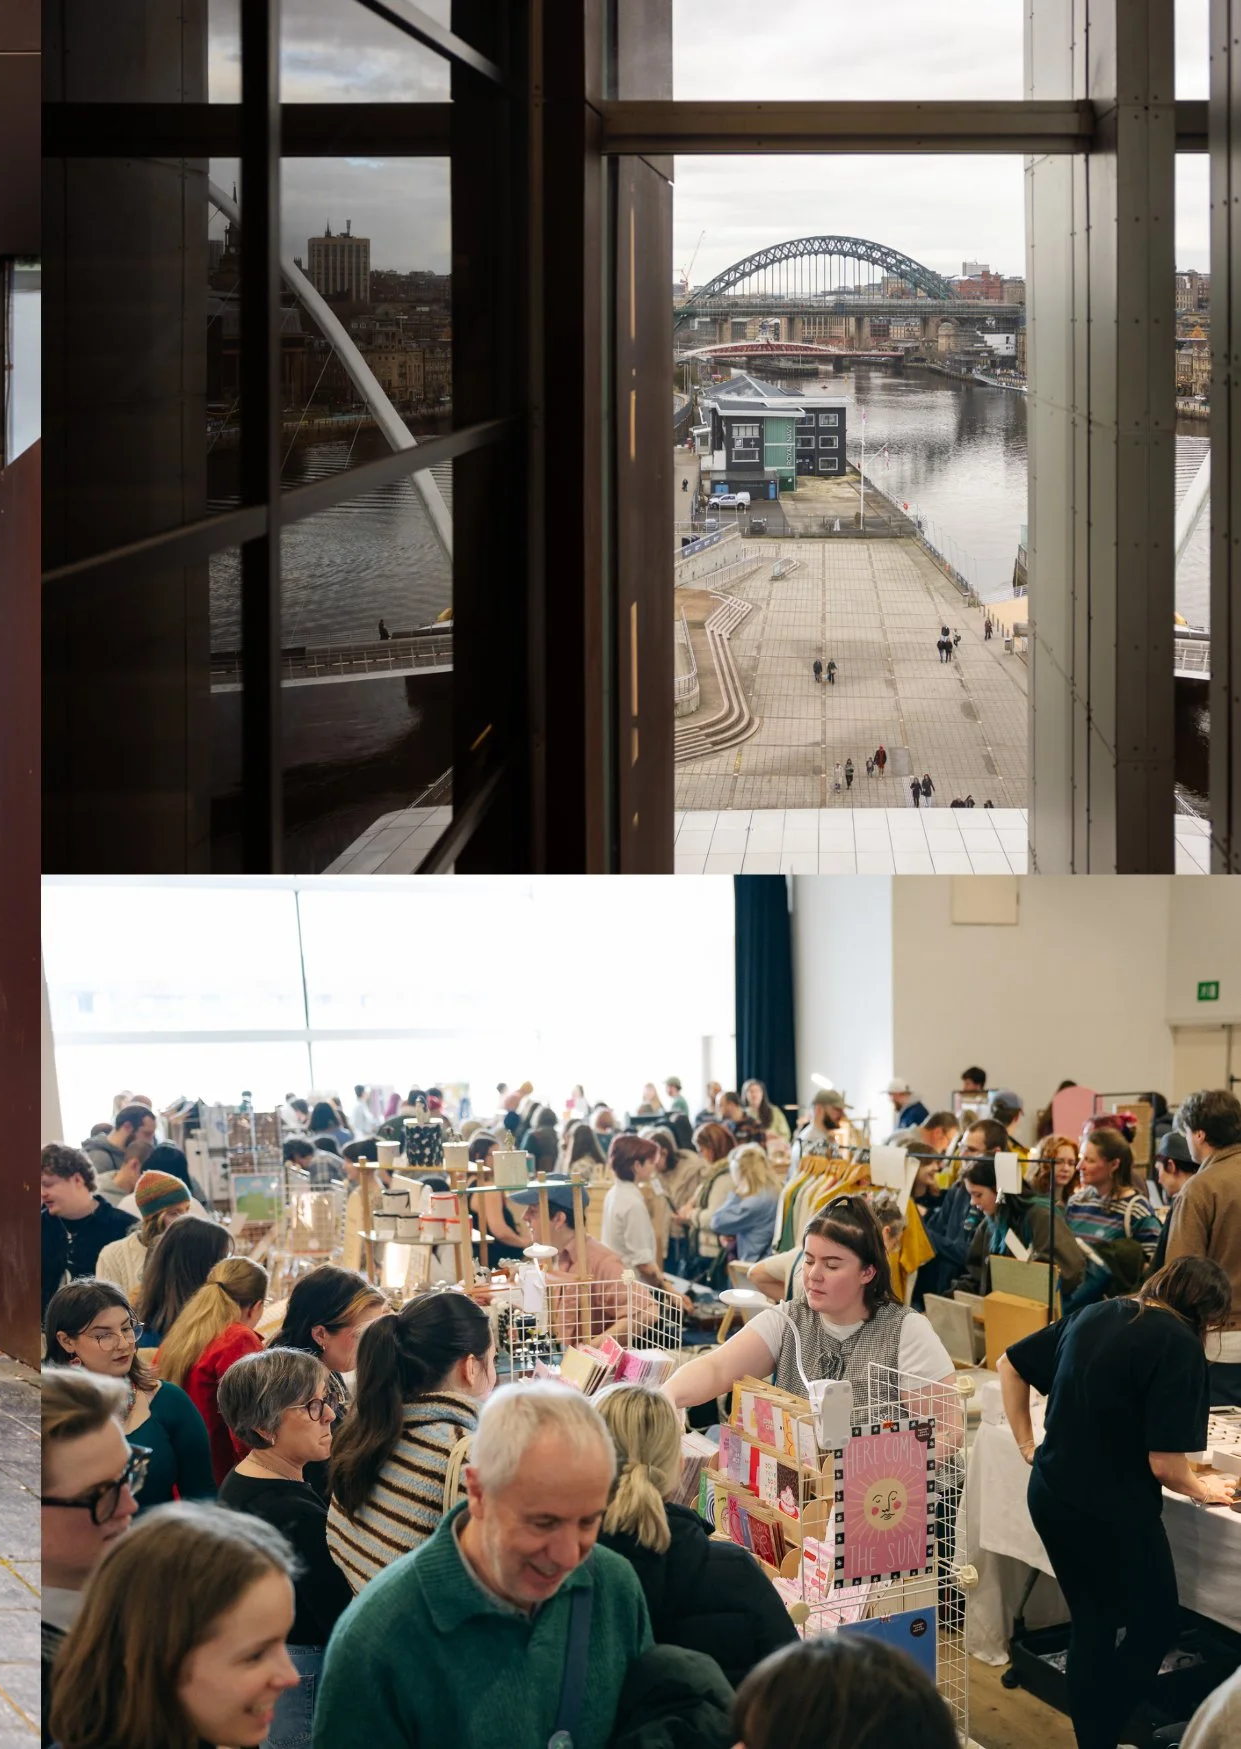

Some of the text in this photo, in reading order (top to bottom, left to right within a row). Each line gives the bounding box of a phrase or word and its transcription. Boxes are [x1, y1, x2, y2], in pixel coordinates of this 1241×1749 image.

[845, 1435, 925, 1481] HERE COMES
[849, 1531, 921, 1575] THE SUN
